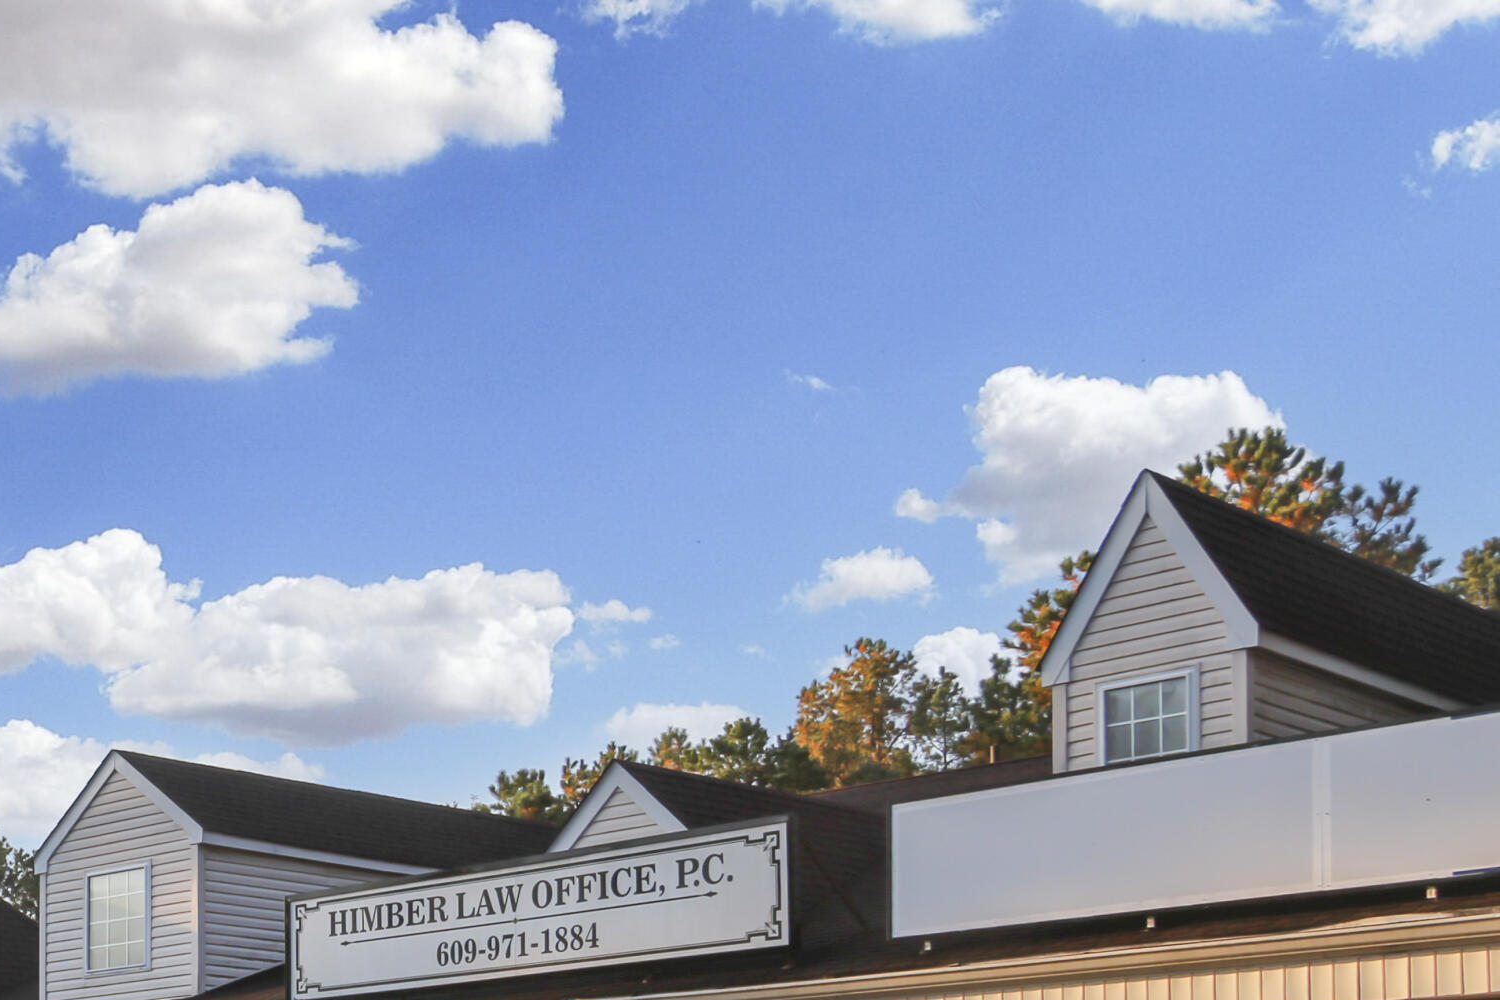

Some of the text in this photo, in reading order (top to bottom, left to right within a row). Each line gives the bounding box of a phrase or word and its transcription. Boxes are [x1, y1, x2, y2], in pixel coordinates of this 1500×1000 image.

[328, 853, 734, 938] HIMBER LAW OFFICE, P.C.
[436, 922, 600, 967] 609-971-1884
